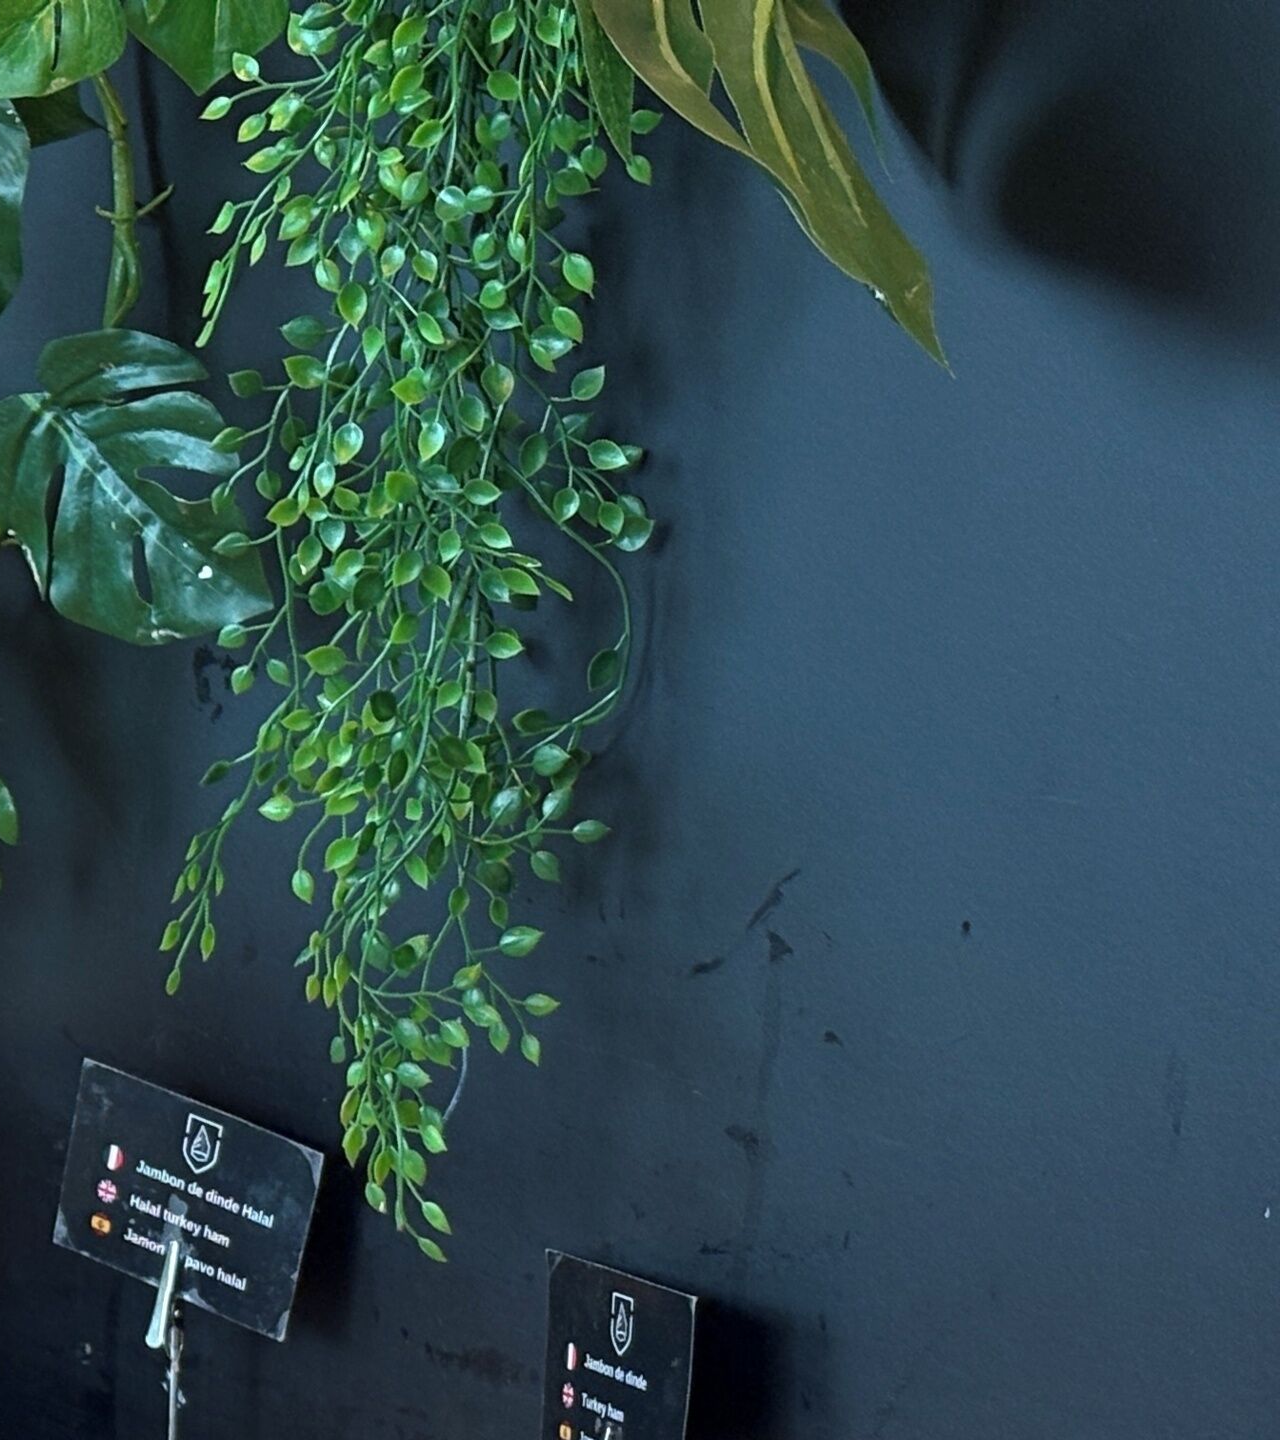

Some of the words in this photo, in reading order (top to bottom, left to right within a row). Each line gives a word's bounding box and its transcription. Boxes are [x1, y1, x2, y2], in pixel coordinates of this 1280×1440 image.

[130, 1193, 161, 1218] Halal
[163, 1208, 201, 1237] turkey
[203, 1226, 230, 1248] ham
[136, 1159, 186, 1192] Jambon
[187, 1180, 203, 1198] de
[205, 1189, 240, 1214] dinde
[242, 1203, 274, 1229] Halal
[123, 1227, 165, 1255] Jamon
[184, 1254, 214, 1278] pavo
[217, 1265, 247, 1291] halal
[583, 1353, 614, 1379] Jambon
[614, 1365, 625, 1381] de
[625, 1370, 648, 1392] dinde
[581, 1392, 607, 1418] Turkey
[607, 1402, 625, 1423] ham
